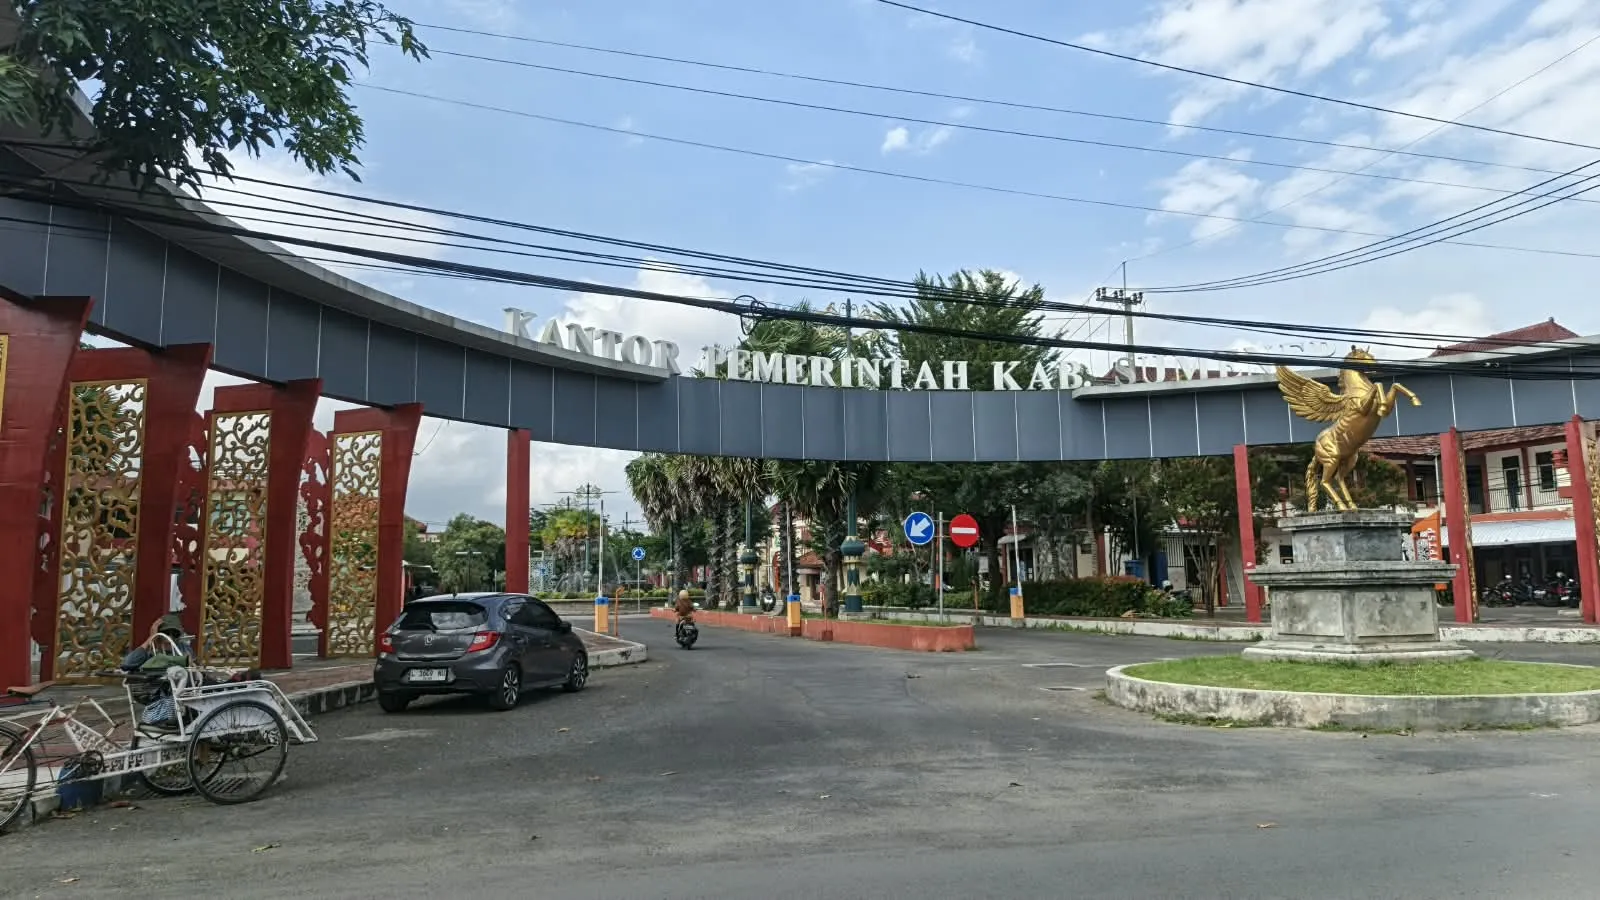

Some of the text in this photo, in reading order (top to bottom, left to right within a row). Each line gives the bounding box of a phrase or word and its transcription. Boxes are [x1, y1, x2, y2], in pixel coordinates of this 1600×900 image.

[503, 307, 681, 375] KANTOR
[704, 345, 970, 390] PEMERINTAH
[991, 360, 1092, 391] KAB.
